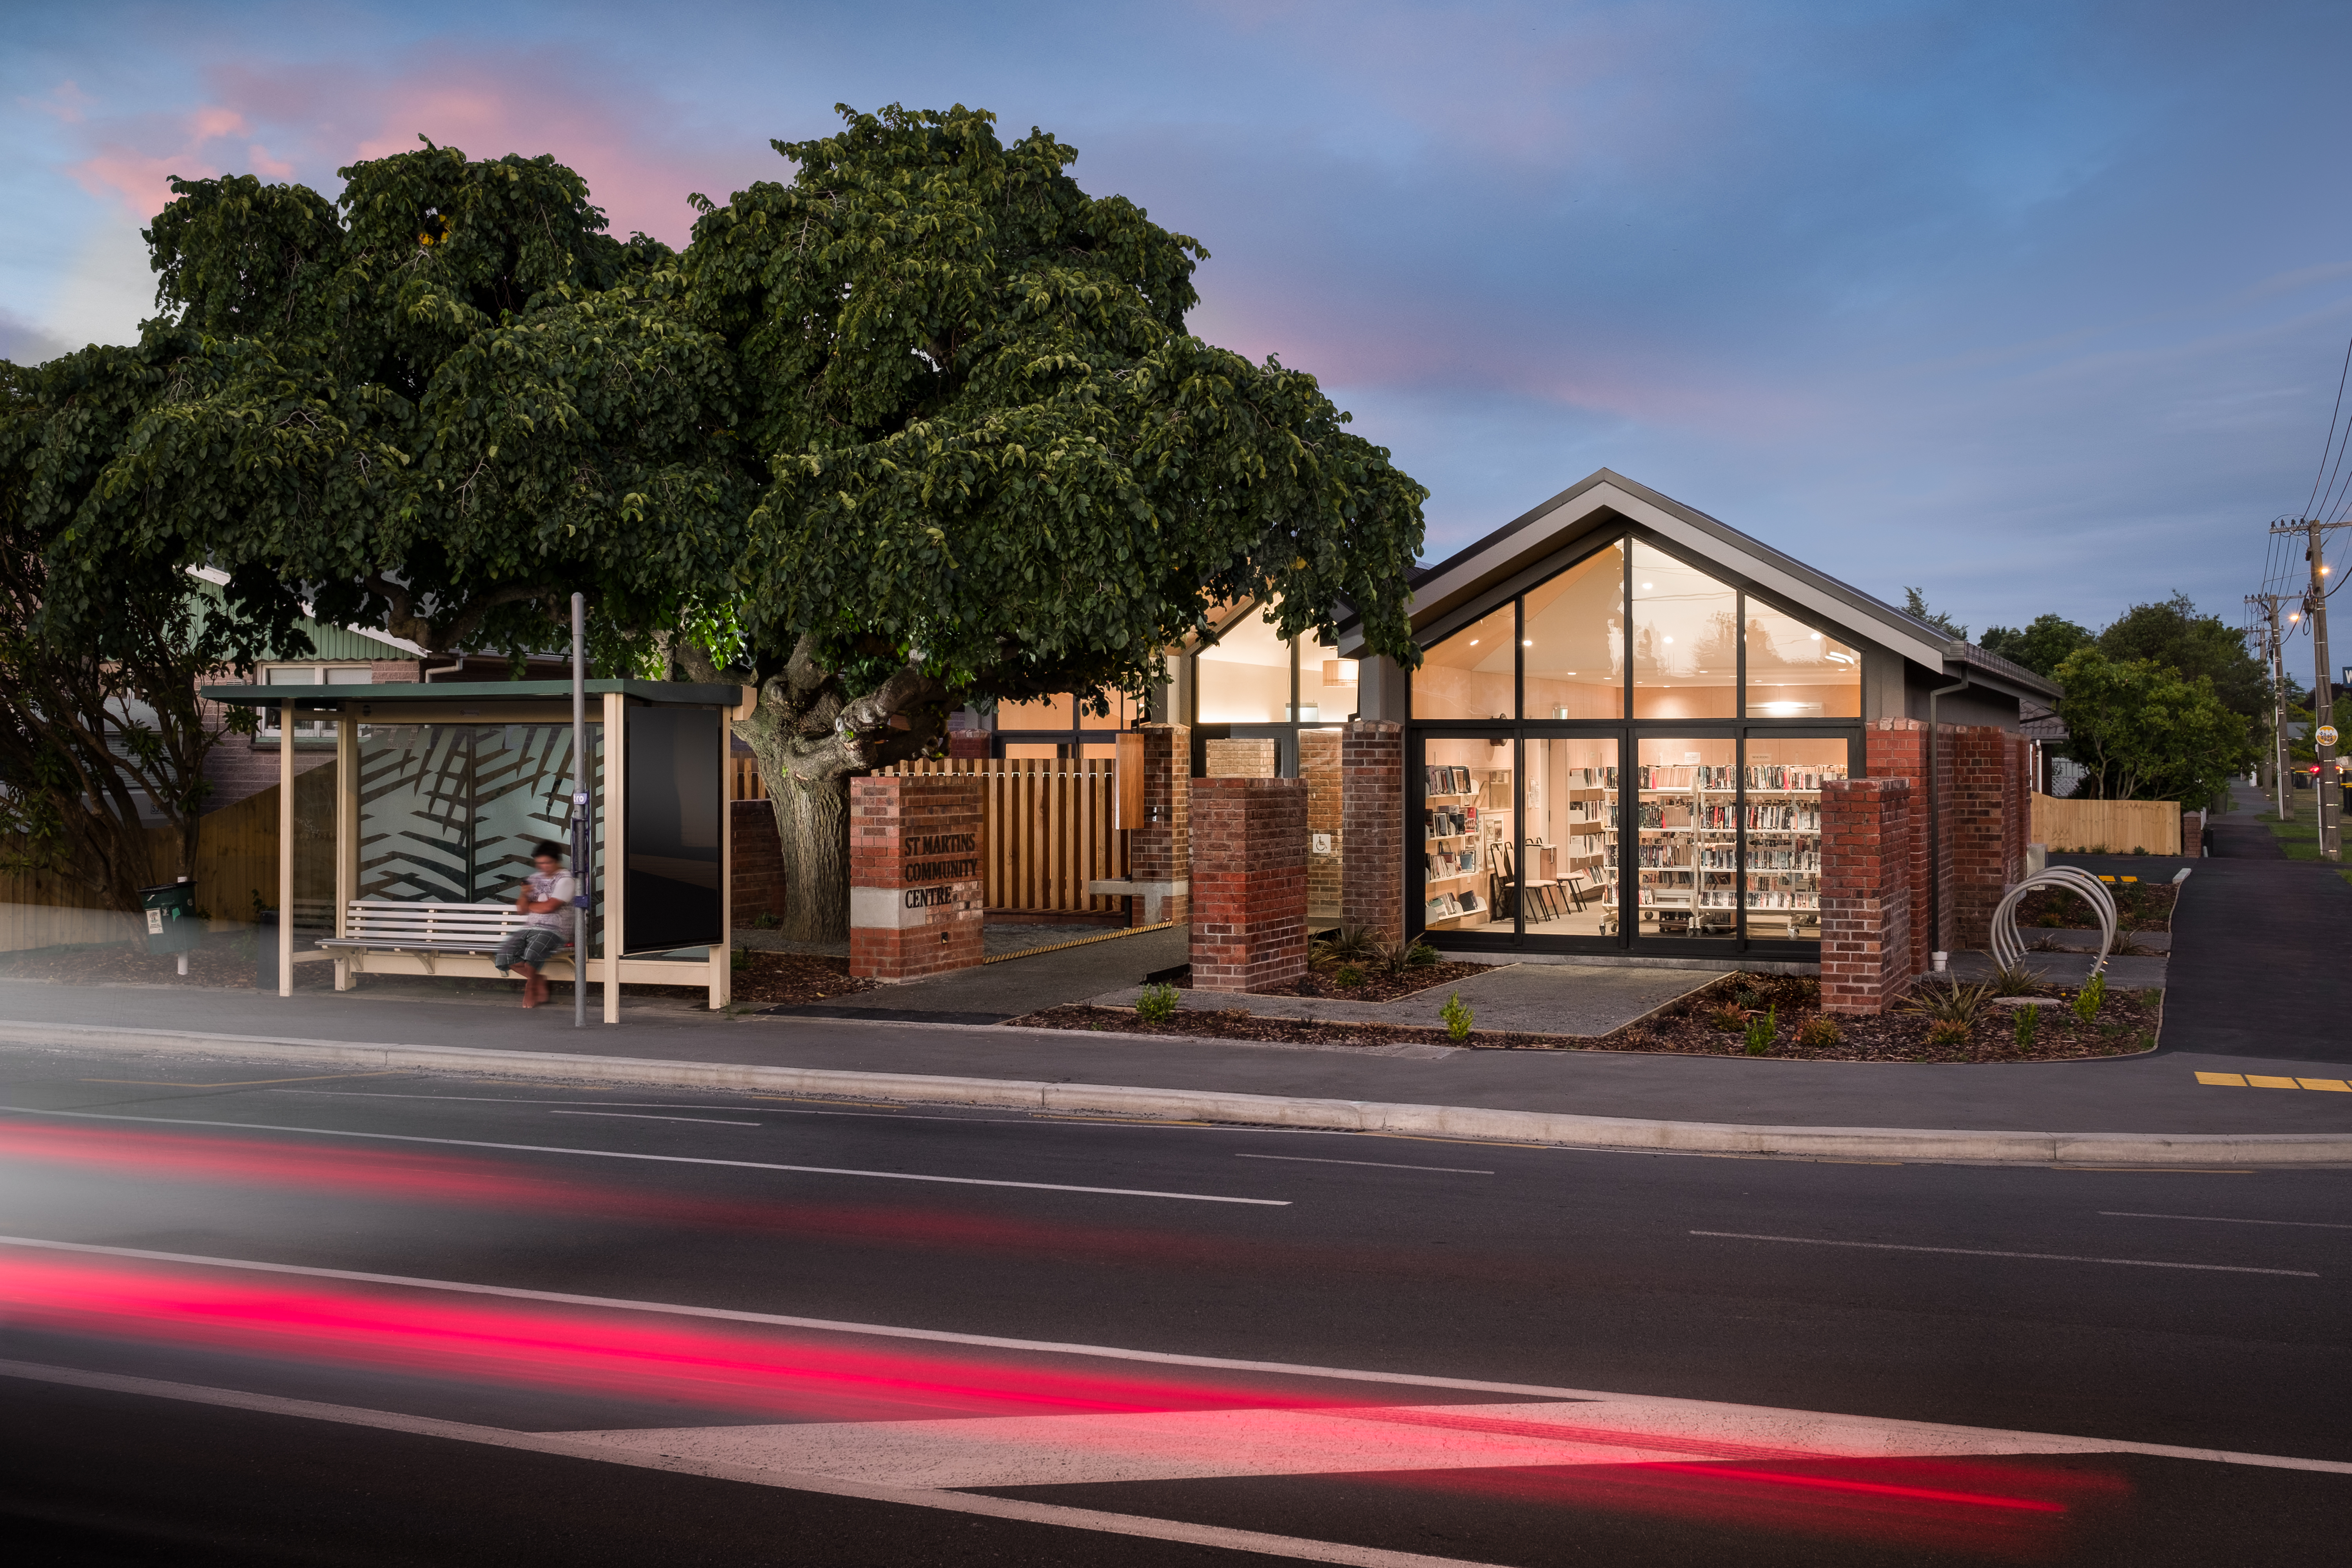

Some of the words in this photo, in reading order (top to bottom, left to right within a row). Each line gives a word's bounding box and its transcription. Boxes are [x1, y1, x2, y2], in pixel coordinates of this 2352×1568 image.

[905, 837, 920, 856] ST
[922, 833, 975, 855] MARTINS
[905, 858, 978, 882] COMMUNITY
[905, 886, 952, 909] CENTRE
